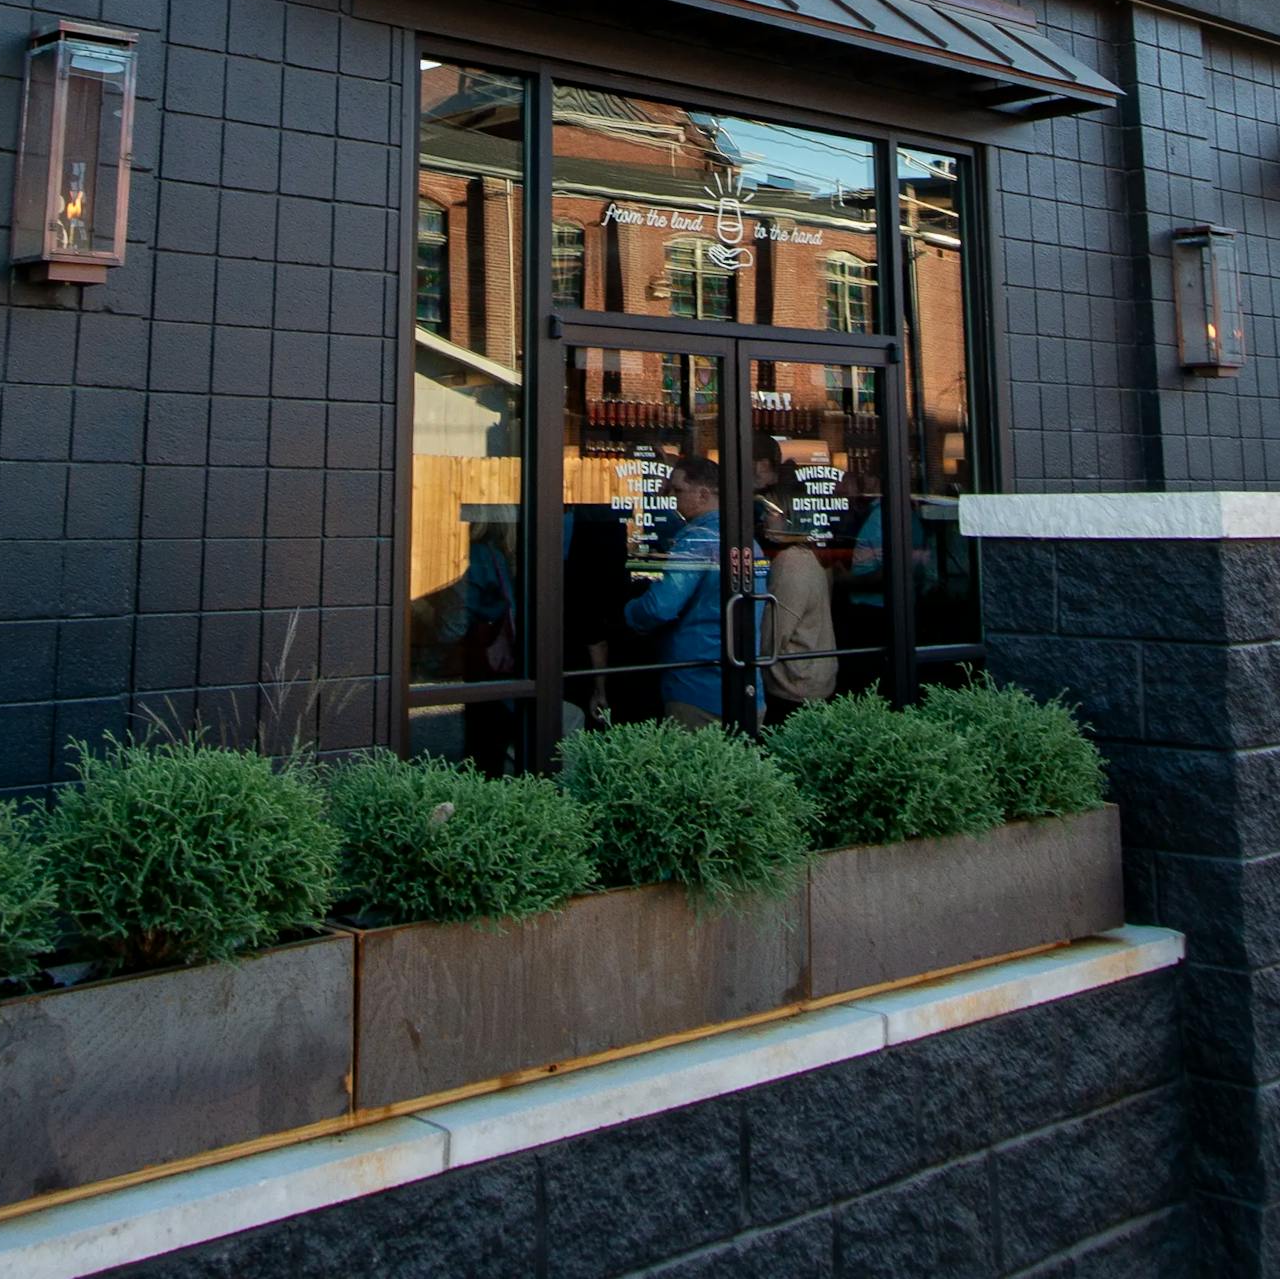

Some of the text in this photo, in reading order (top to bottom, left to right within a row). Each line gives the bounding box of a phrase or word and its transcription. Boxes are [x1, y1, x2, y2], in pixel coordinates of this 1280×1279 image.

[601, 203, 705, 231] from the land
[754, 222, 823, 246] to the hand
[614, 460, 674, 480] WHISKEY
[795, 465, 845, 482] WHISKEY
[627, 479, 662, 493] THIEF
[804, 482, 837, 495] THIEF
[611, 495, 678, 510] DISTILLING
[792, 497, 850, 511] DISTILLING
[635, 512, 656, 527] CO.
[812, 512, 831, 527] CO.
